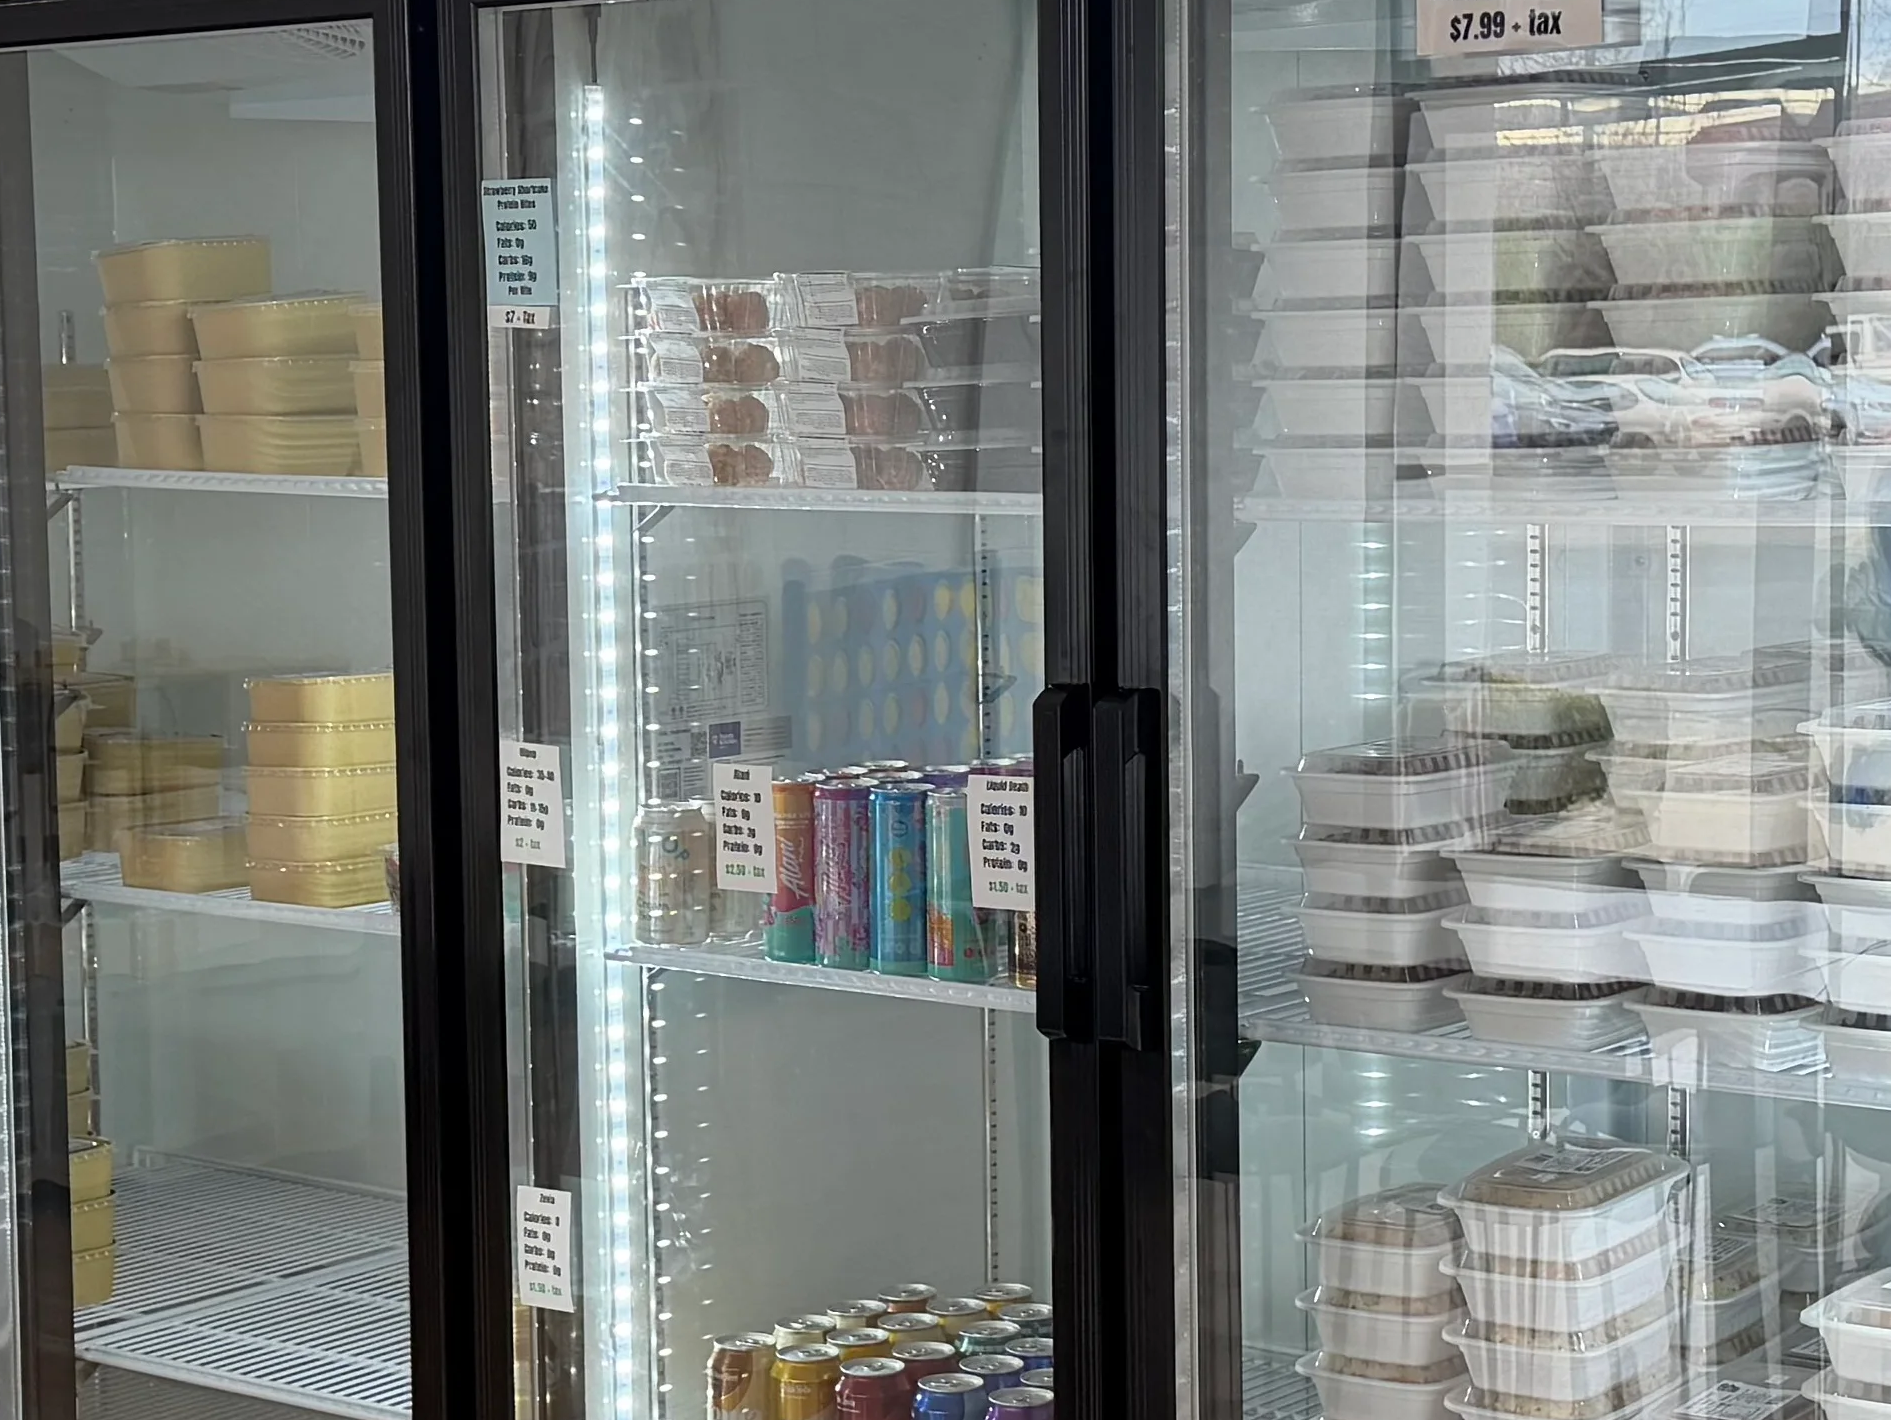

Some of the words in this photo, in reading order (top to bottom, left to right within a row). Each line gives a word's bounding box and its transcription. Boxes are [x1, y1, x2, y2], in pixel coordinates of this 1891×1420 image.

[1449, 10, 1506, 43] $7.99
[1528, 8, 1562, 36] tax
[986, 780, 1008, 792] Liquid
[1008, 781, 1029, 793] Death
[980, 803, 1015, 816] Calories:
[981, 821, 1000, 833] Fats:
[982, 838, 1008, 851] Carbs:
[983, 856, 1014, 870] Protein:
